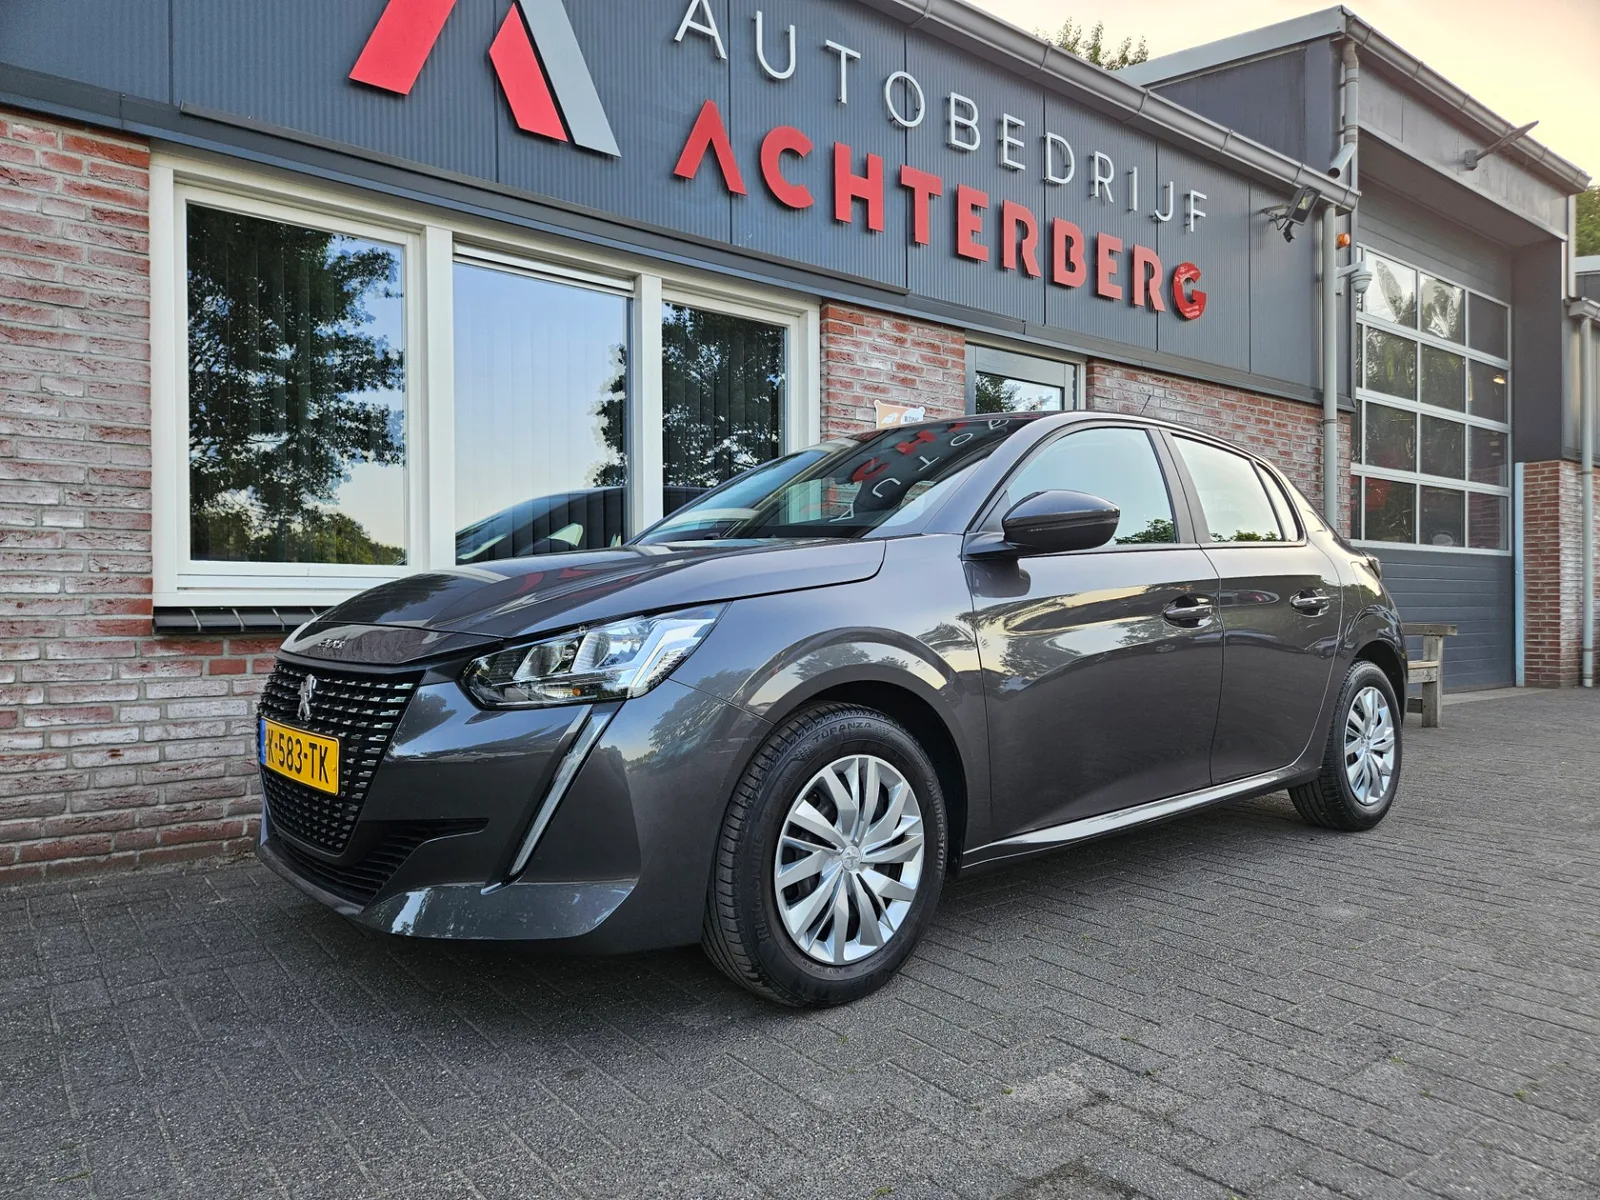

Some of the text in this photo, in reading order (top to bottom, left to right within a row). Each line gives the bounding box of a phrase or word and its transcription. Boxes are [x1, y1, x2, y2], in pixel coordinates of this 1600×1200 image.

[674, 0, 1208, 232] AUTOBEDRIJF
[673, 99, 1208, 321] ACHTERBERG
[267, 728, 329, 784] K-583-TK
[812, 721, 873, 744] TURANZA
